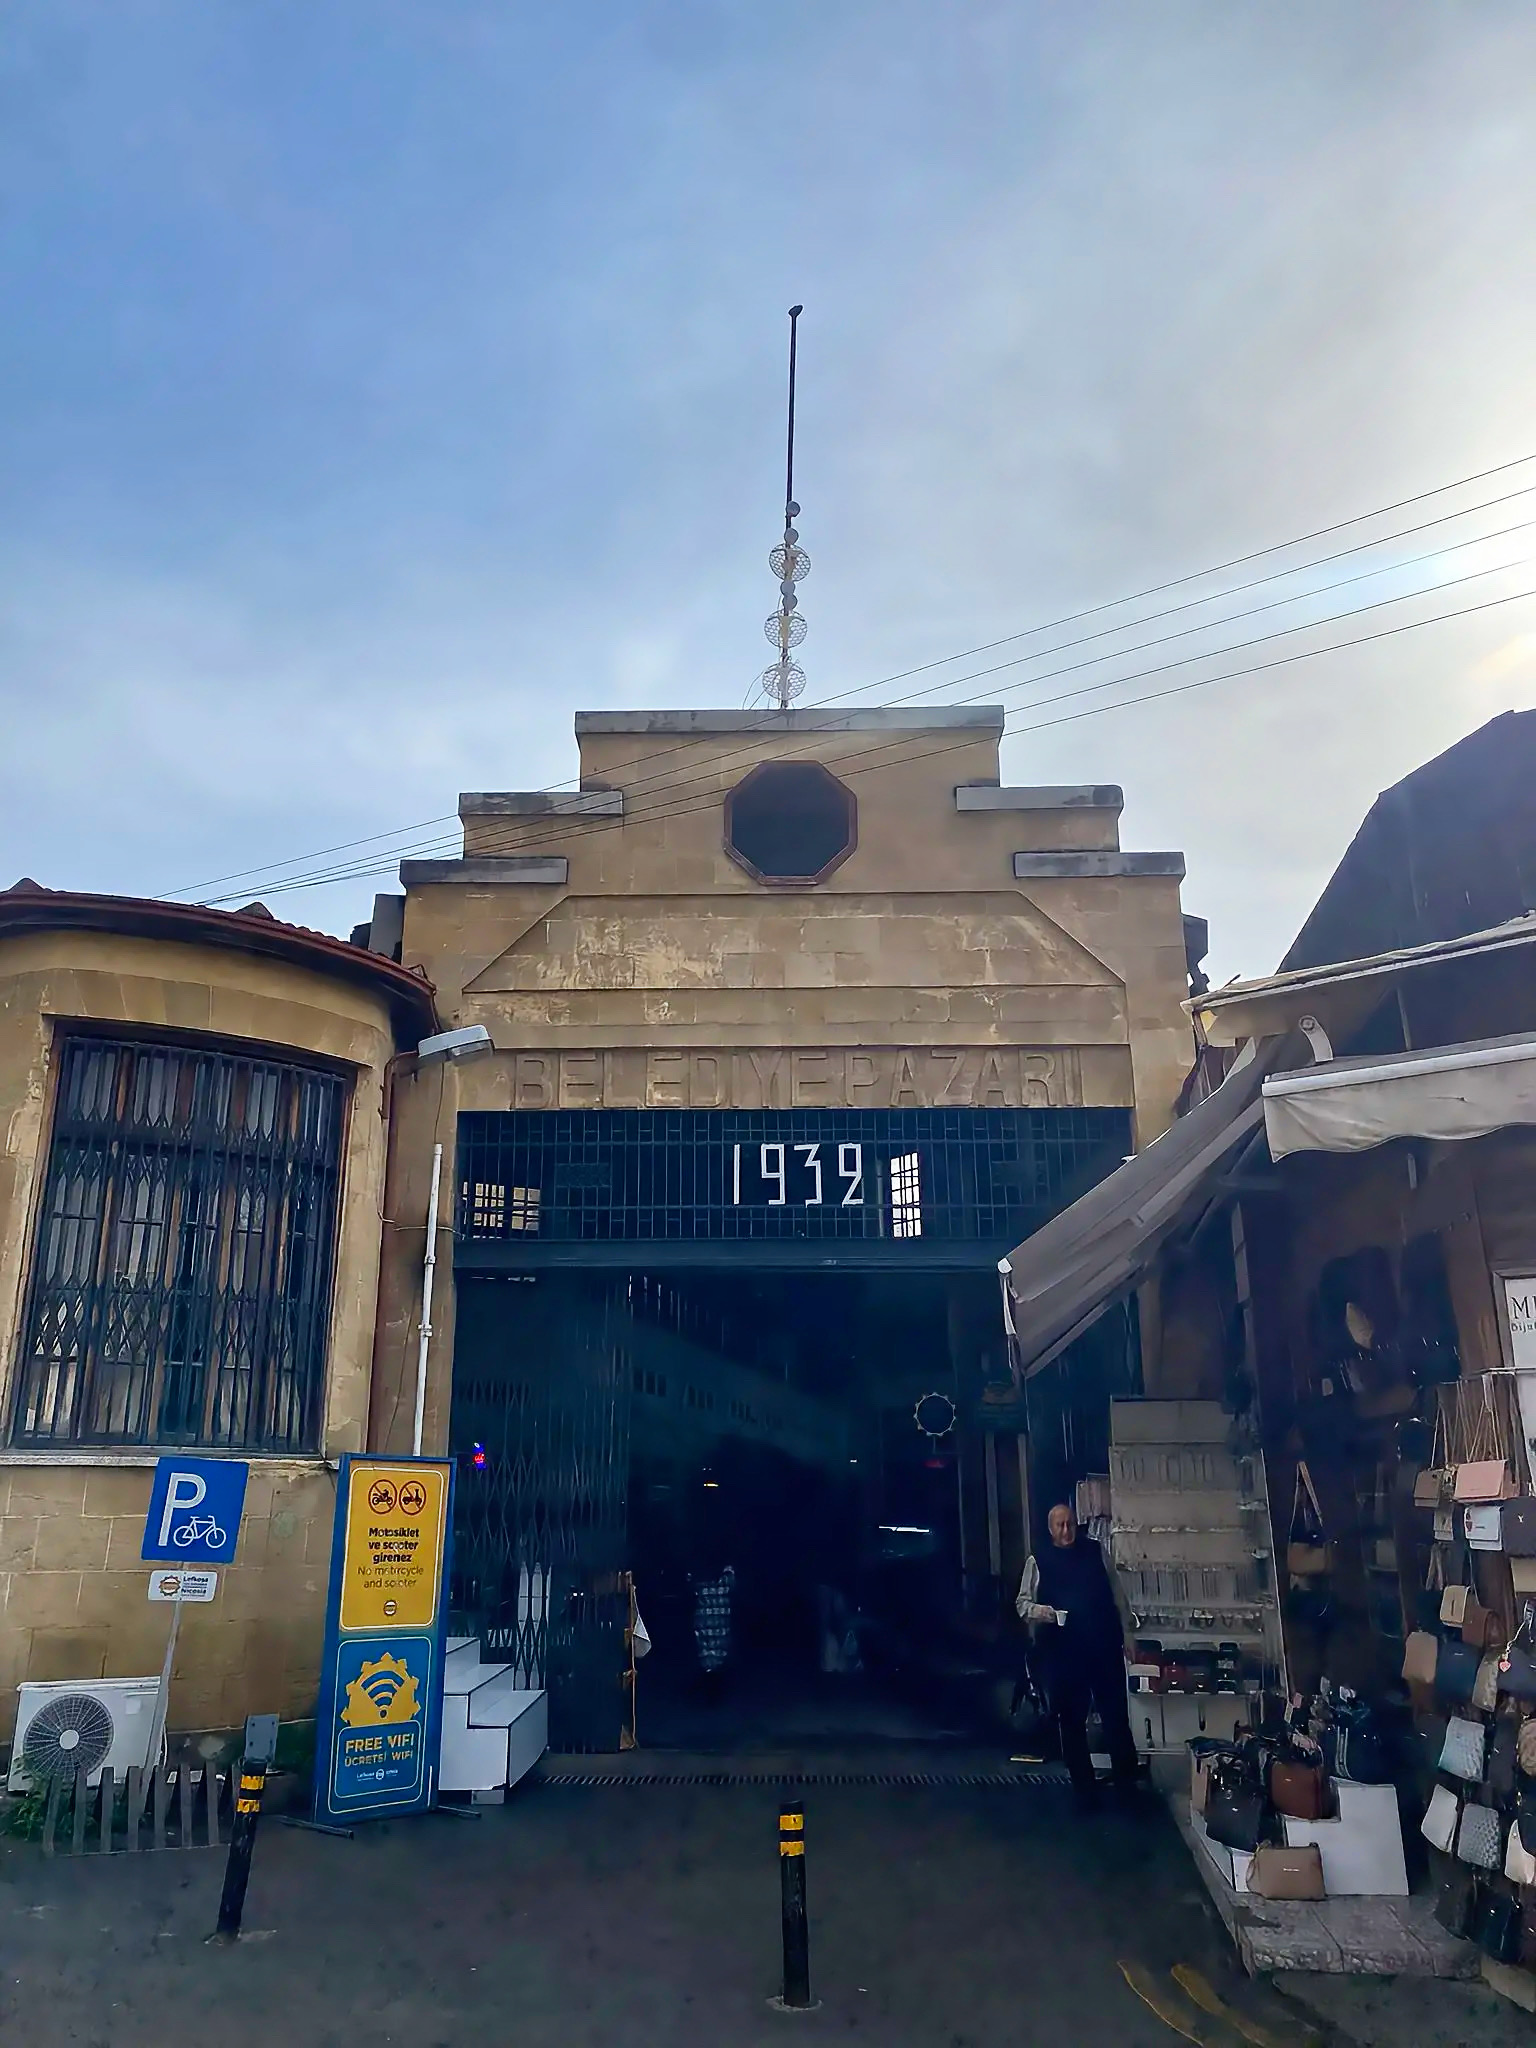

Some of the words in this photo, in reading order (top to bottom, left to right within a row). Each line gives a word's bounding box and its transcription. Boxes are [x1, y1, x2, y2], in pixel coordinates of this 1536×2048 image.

[158, 1472, 207, 1546] P
[368, 1541, 381, 1550] ve
[357, 1566, 373, 1576] No
[363, 1578, 383, 1588] and
[345, 1736, 383, 1754] FREE
[391, 1750, 414, 1760] WIFI
